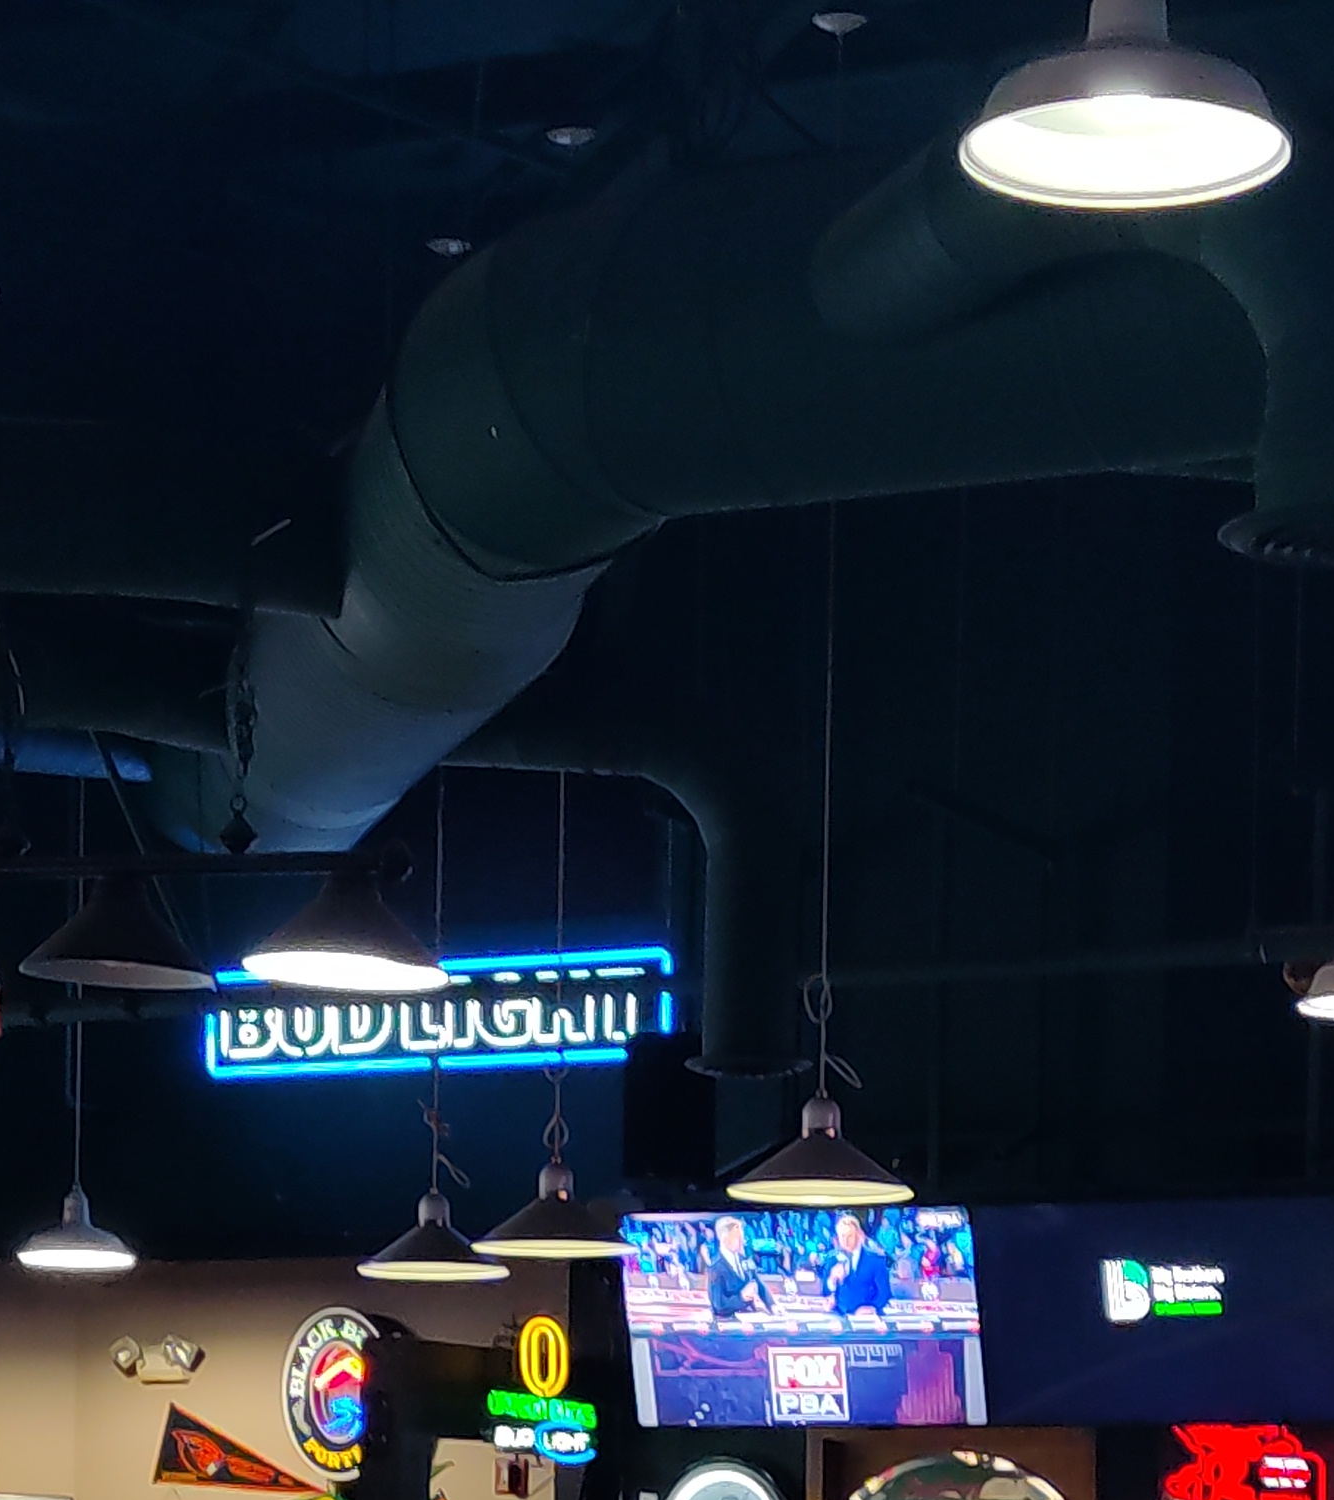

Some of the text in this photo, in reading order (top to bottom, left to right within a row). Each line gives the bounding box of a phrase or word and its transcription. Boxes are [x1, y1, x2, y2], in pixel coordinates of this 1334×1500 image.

[219, 1000, 395, 1059] BUD
[289, 1318, 339, 1398] BLACK
[775, 1354, 841, 1387] FOX
[779, 1393, 845, 1417] PBA
